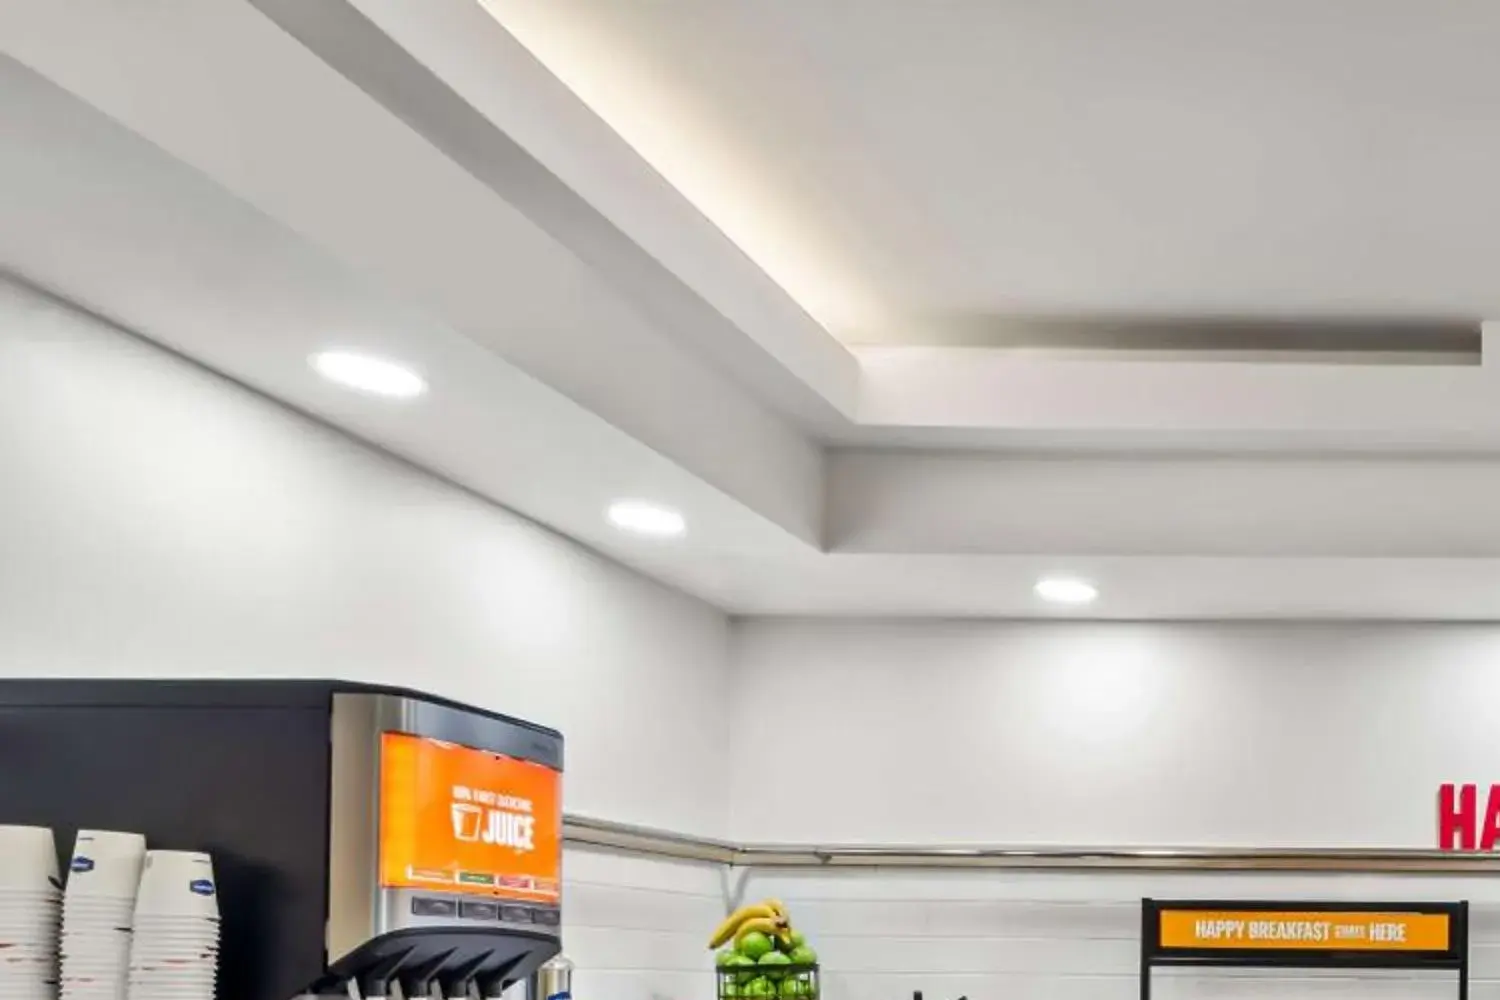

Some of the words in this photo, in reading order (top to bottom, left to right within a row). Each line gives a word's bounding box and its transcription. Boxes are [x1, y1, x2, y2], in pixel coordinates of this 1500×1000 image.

[483, 808, 536, 851] JUICE
[1195, 920, 1245, 939] HAPPY
[1248, 921, 1330, 940] BREAKFAST
[1369, 923, 1406, 941] HERE
